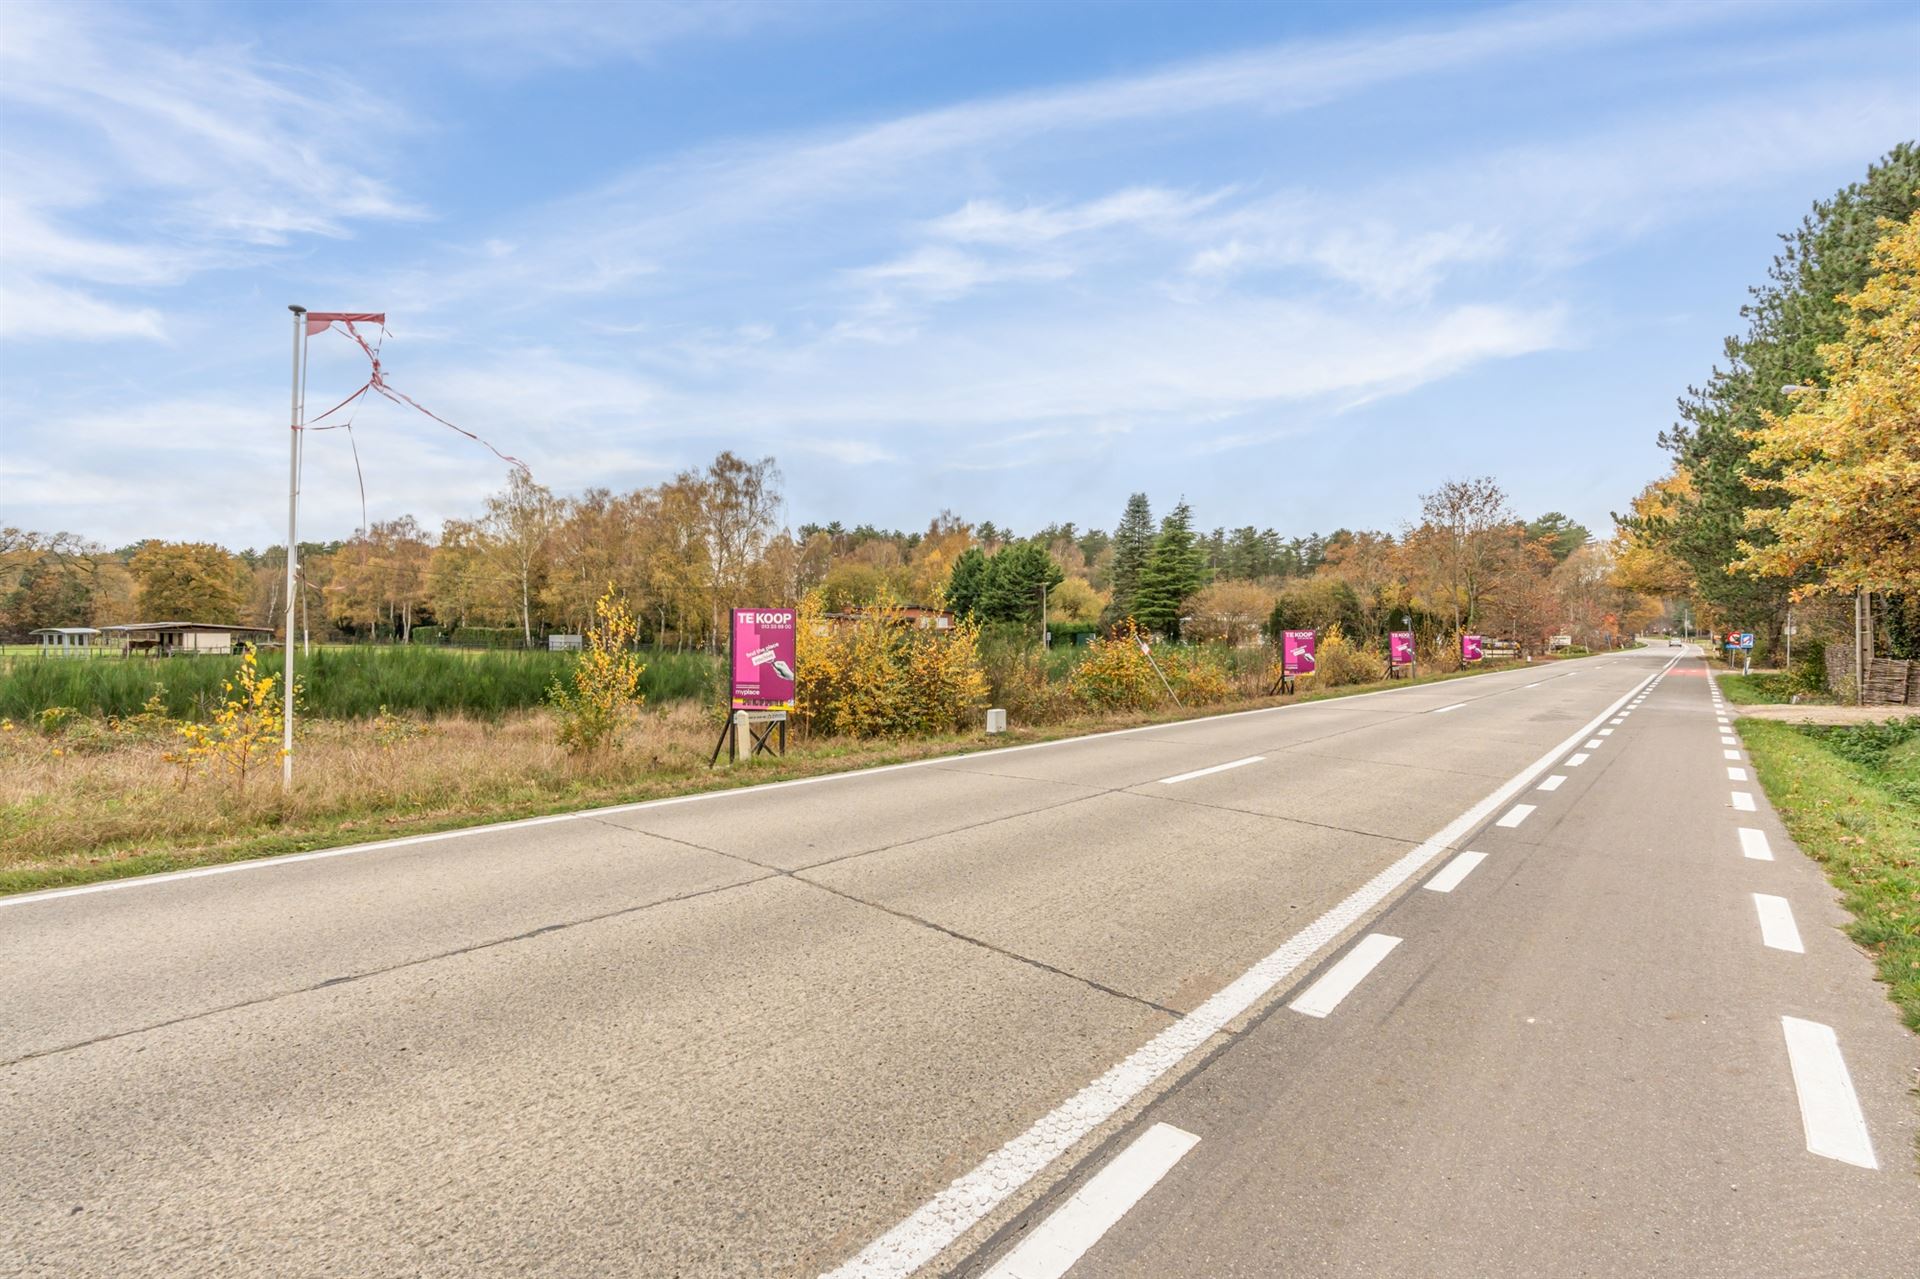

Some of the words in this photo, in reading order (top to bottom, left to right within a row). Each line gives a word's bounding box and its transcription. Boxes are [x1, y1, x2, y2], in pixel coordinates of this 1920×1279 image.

[737, 612, 755, 624] TE
[756, 612, 792, 624] KOOP
[765, 642, 779, 652] place
[735, 688, 760, 696] myplace
